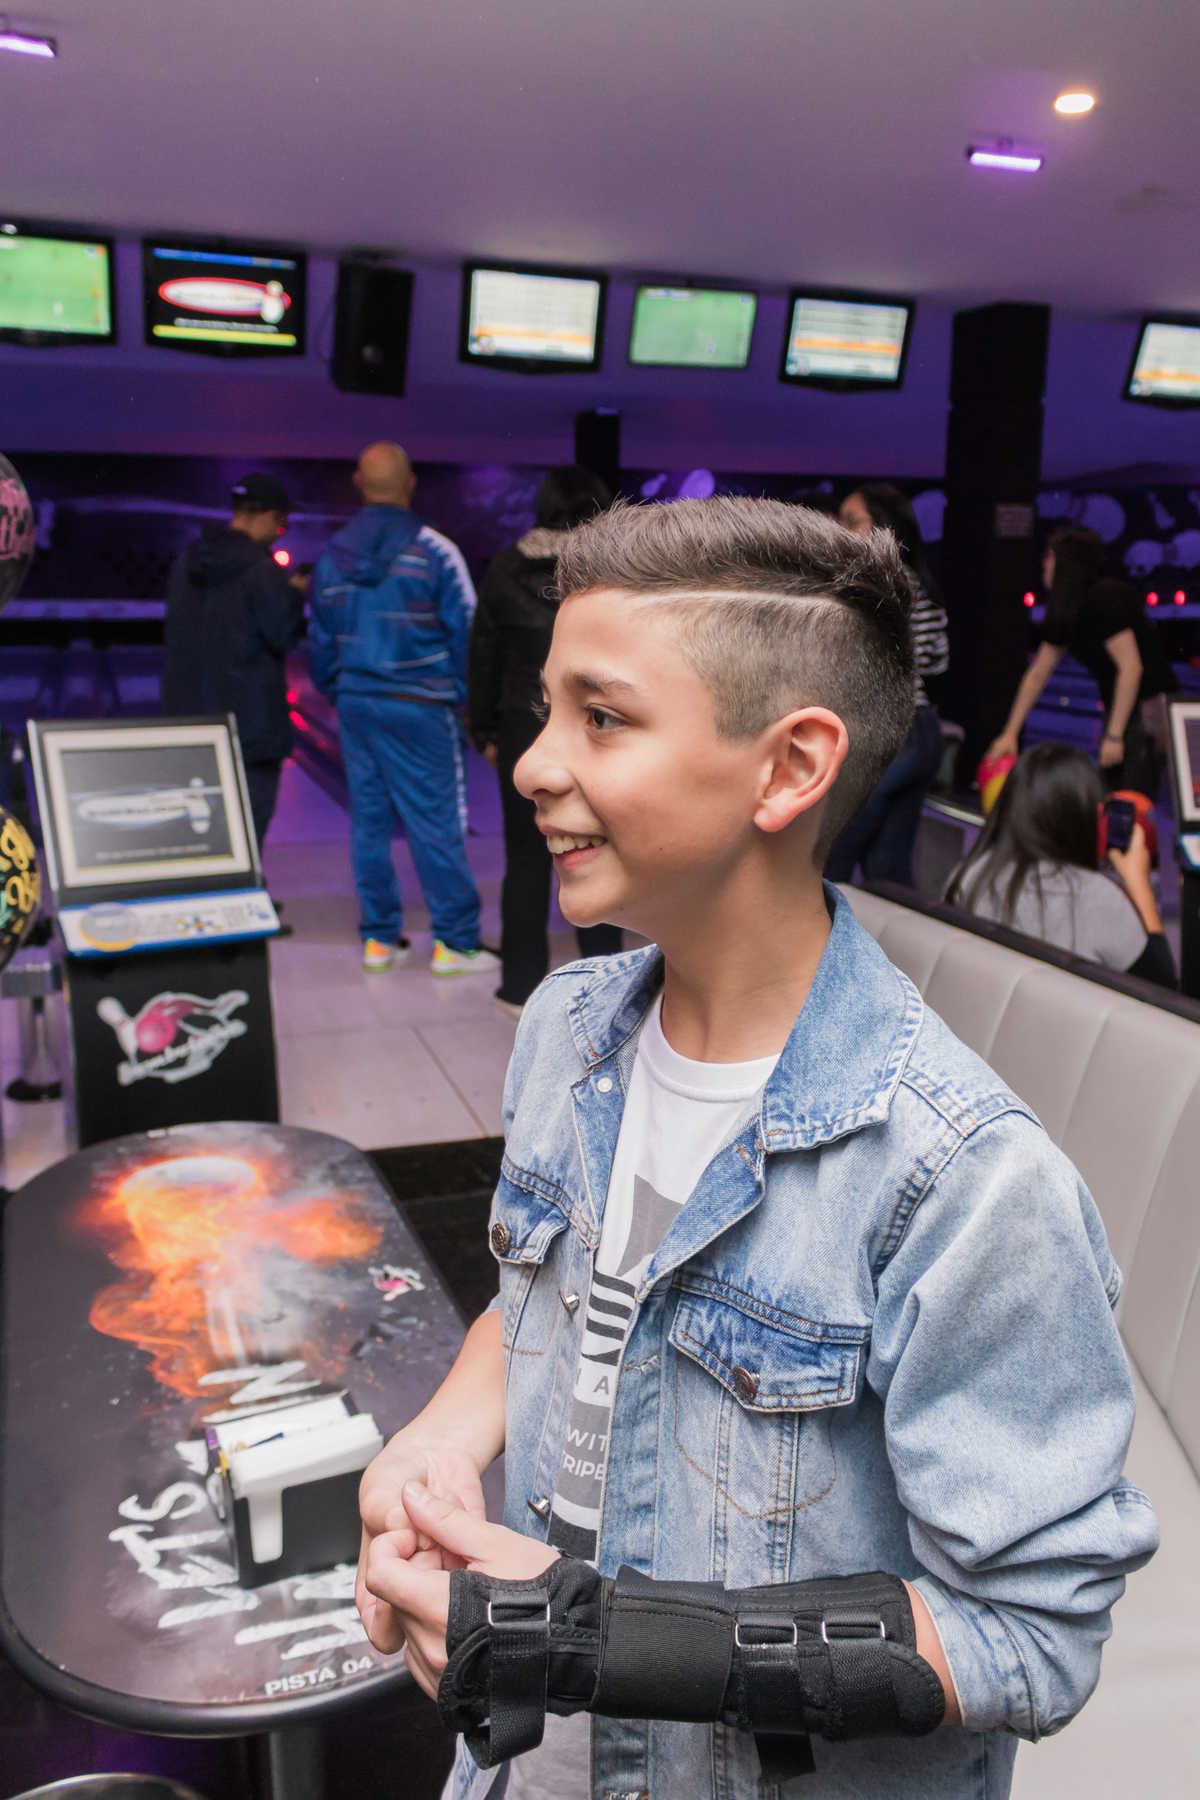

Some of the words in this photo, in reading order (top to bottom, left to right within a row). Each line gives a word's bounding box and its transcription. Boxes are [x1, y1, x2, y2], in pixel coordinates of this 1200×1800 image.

[566, 1424, 609, 1452] WIT
[562, 1448, 607, 1481] RIPE
[265, 1668, 337, 1697] PISTA
[343, 1655, 374, 1675] 04
